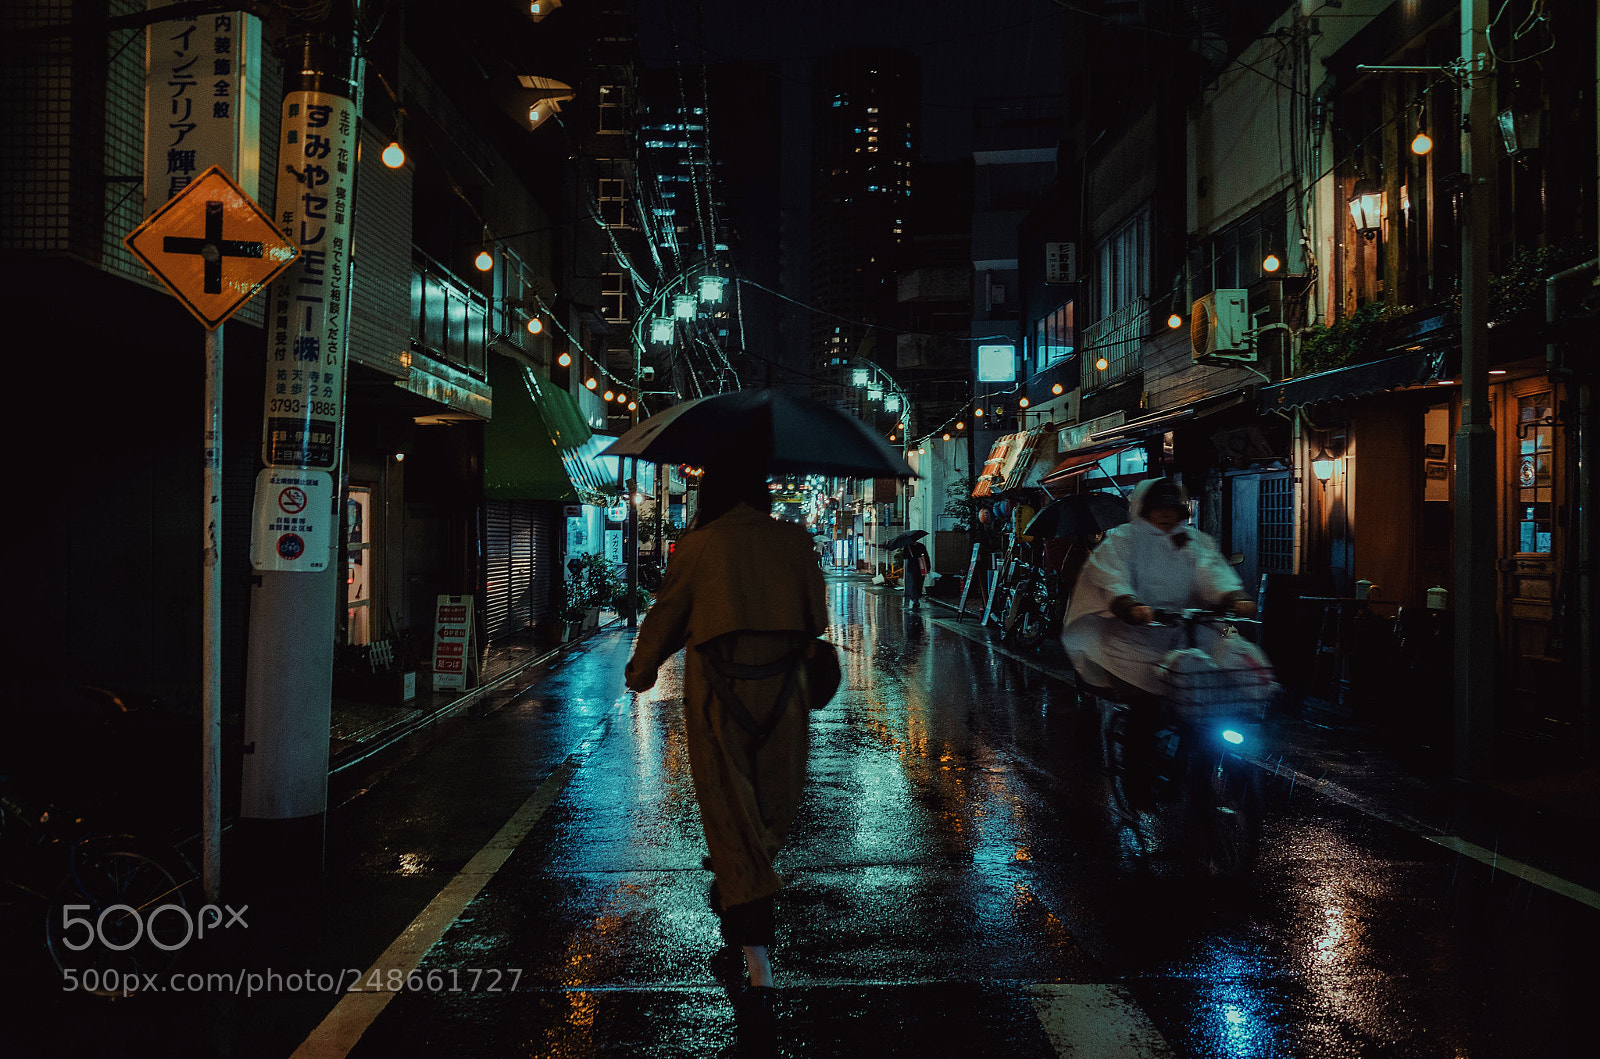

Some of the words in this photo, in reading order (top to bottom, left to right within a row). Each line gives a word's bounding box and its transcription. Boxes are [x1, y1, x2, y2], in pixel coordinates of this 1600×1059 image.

[213, 15, 231, 118] 内装飾全般
[270, 398, 336, 416] 3793-0885
[444, 629, 465, 637] OPEN
